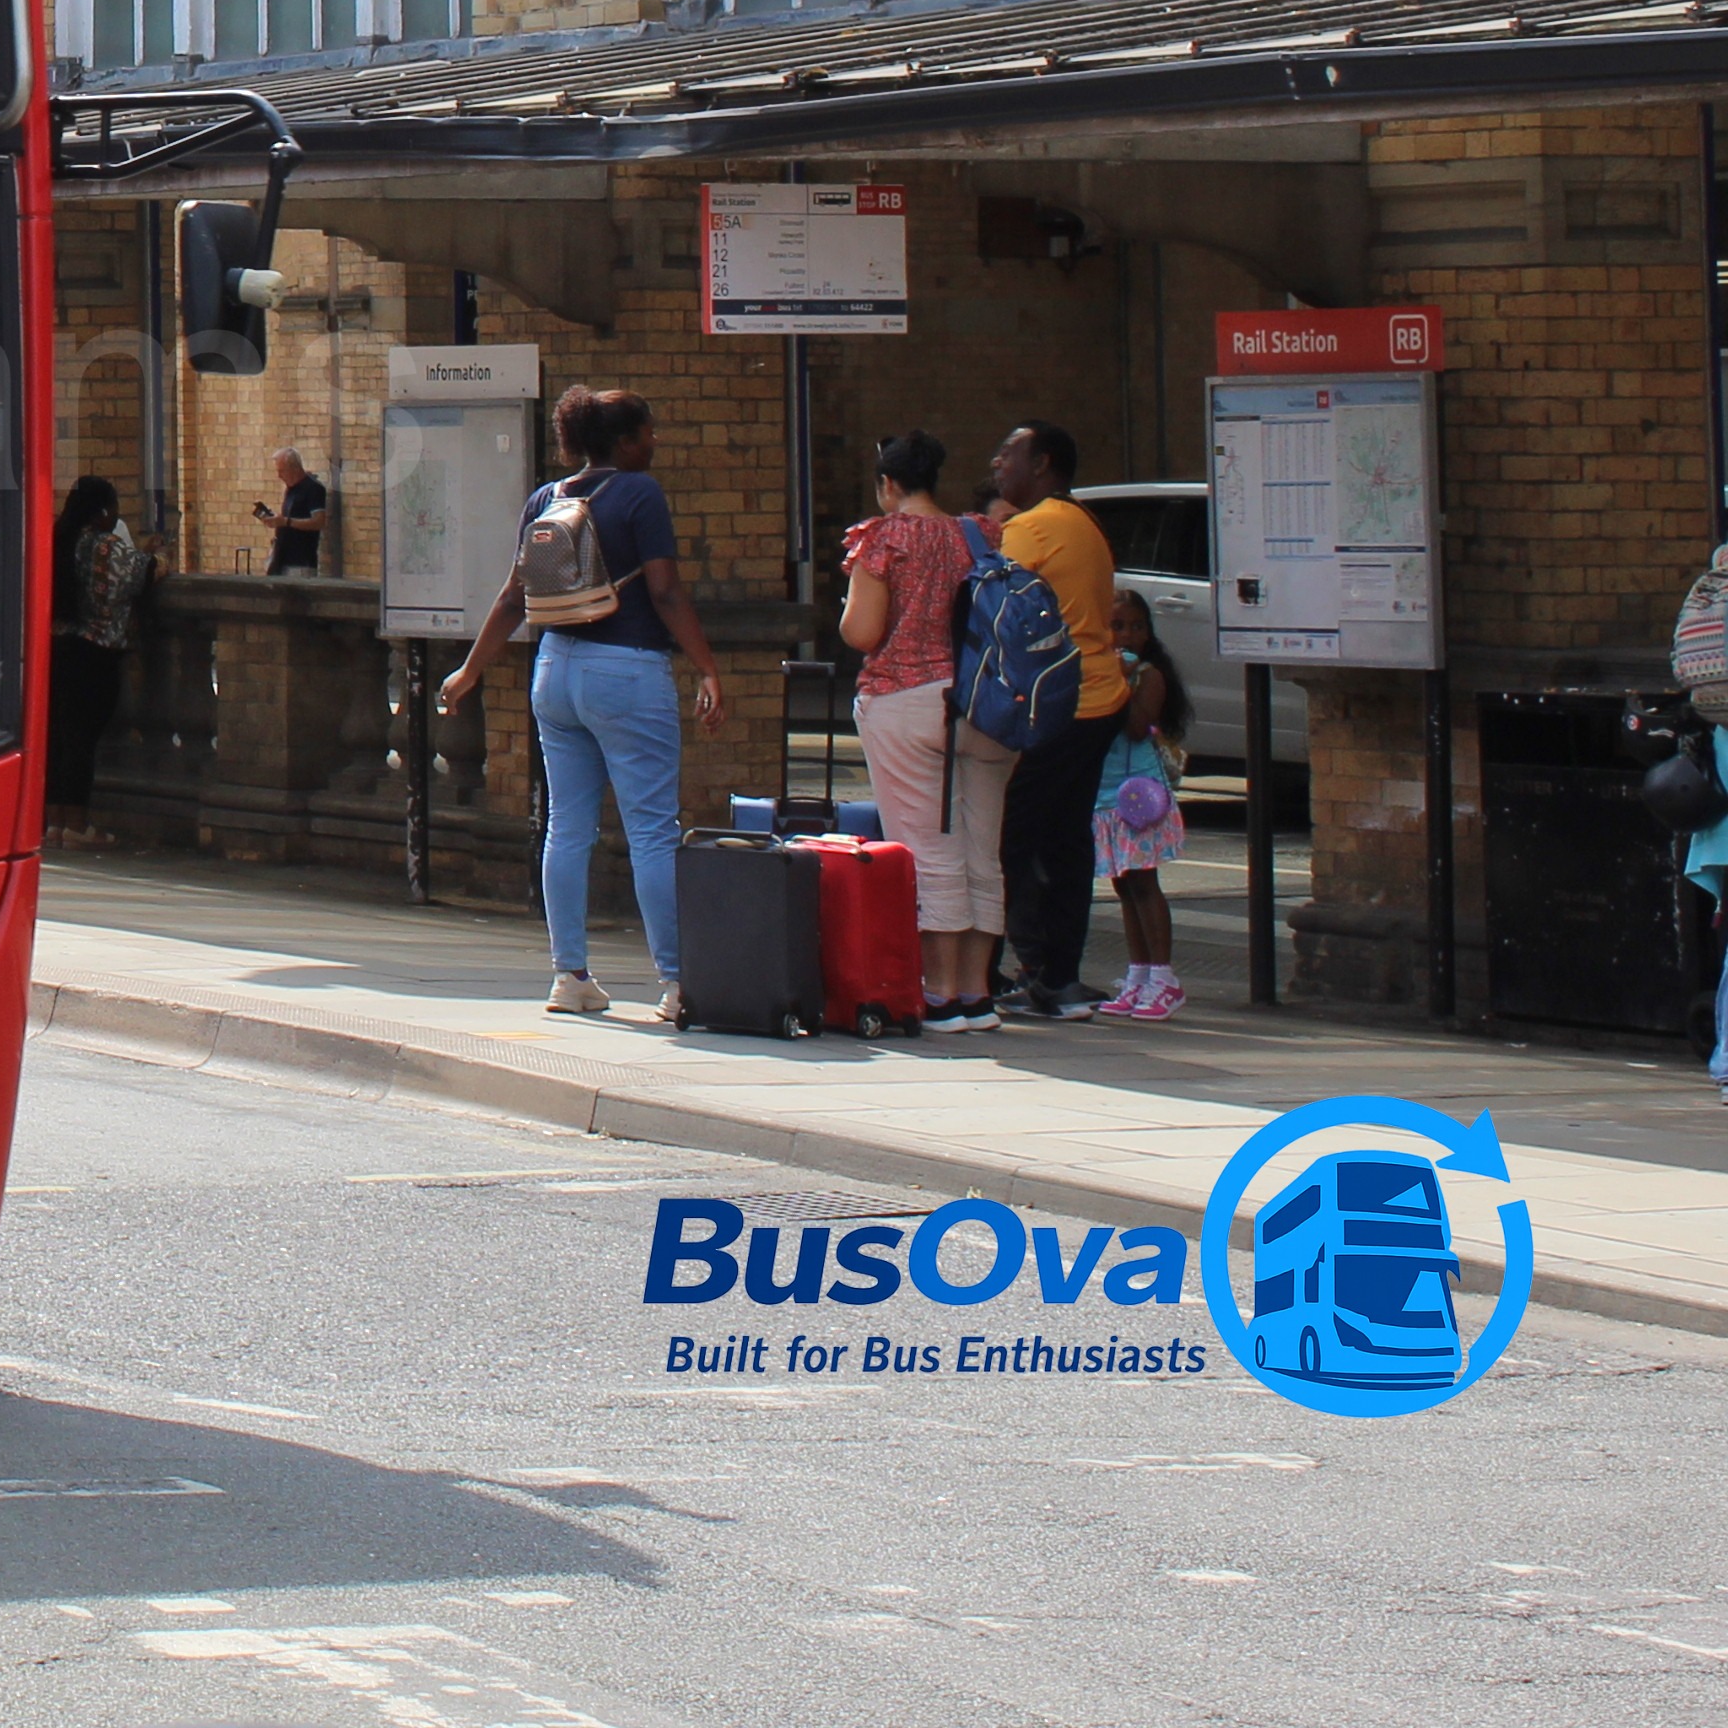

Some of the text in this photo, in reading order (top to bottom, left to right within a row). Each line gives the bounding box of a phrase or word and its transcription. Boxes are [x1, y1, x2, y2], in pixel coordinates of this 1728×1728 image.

[878, 192, 902, 209] RB
[724, 215, 742, 229] 5A
[713, 232, 727, 245] 11
[713, 249, 729, 262] 12
[712, 264, 727, 278] 21
[712, 282, 730, 296] 26
[1233, 327, 1422, 354] Rail Station RB
[425, 363, 492, 381] Information
